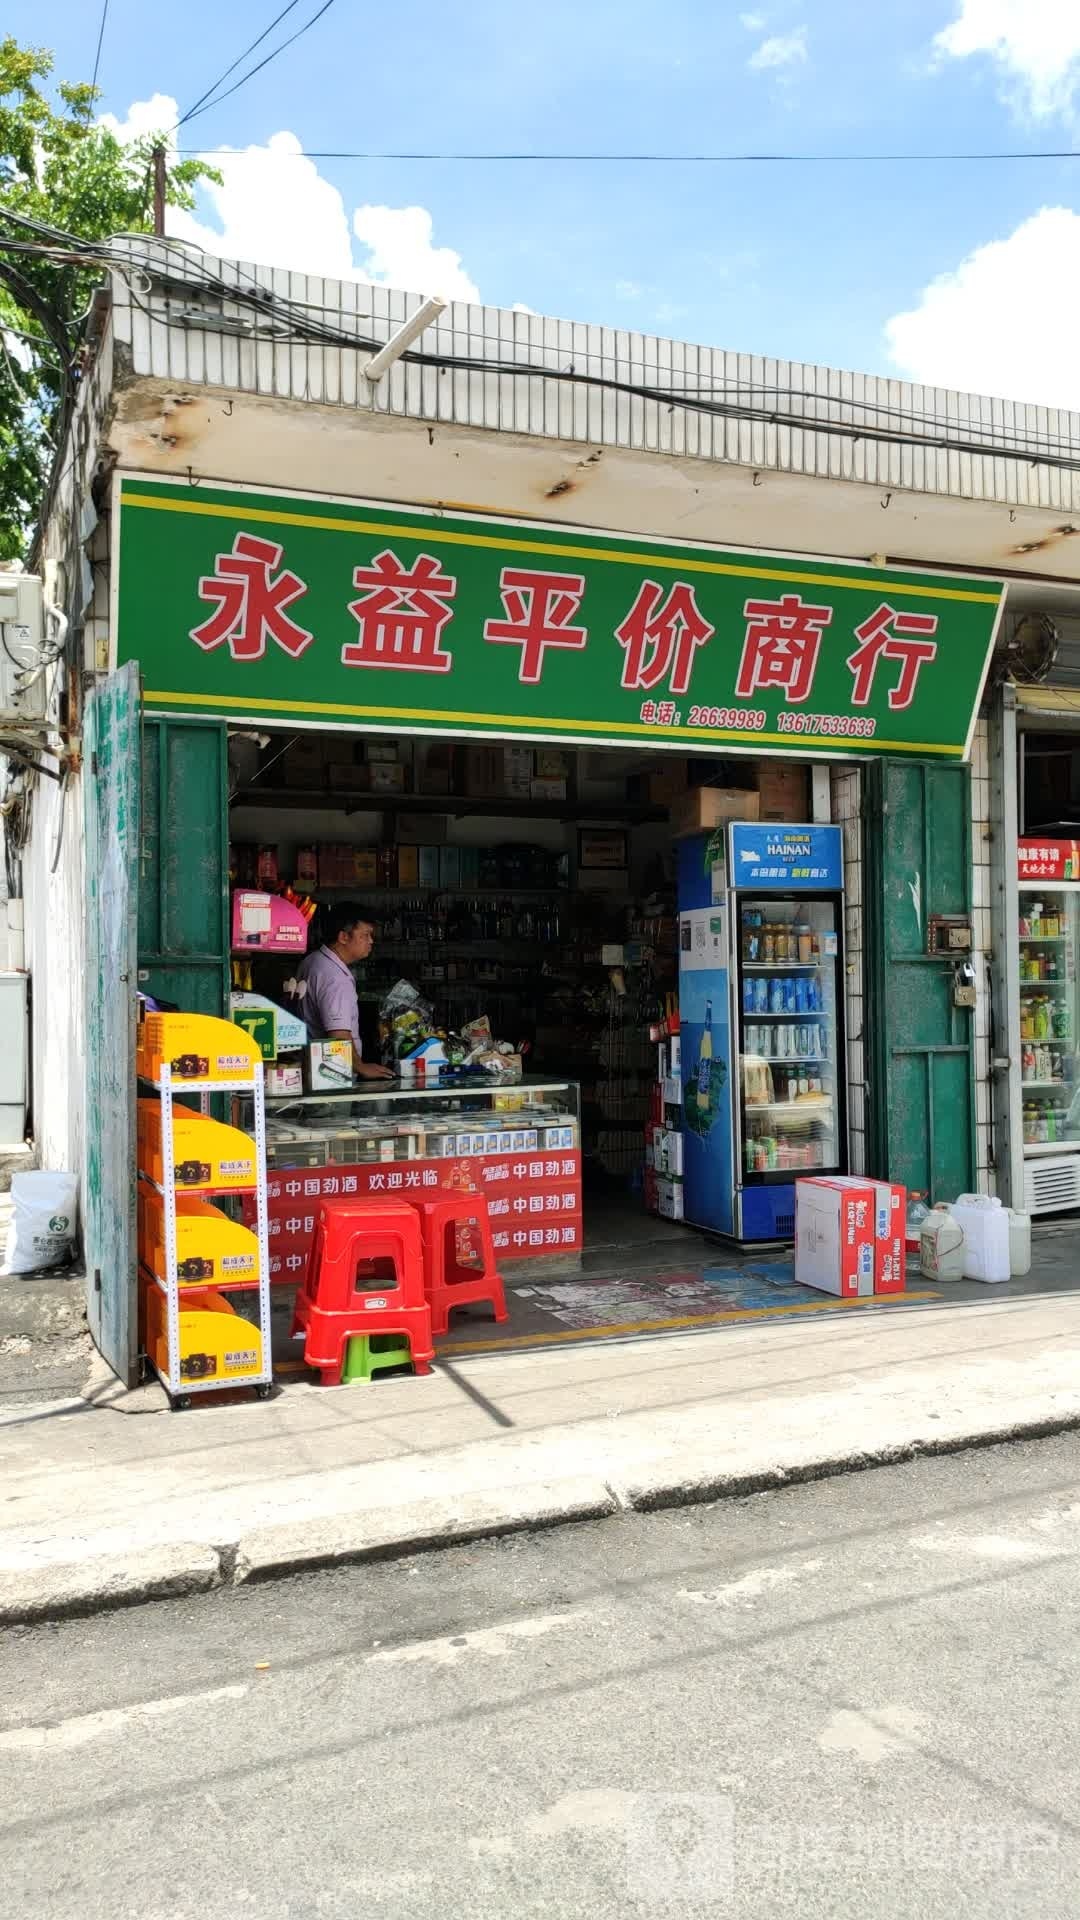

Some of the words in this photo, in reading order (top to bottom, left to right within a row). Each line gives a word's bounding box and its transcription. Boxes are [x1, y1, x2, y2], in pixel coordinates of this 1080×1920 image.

[189, 532, 938, 709] 永益平价商行
[640, 700, 681, 726] 电话：
[687, 705, 766, 730] 26639989
[777, 712, 877, 737] 13617533633
[767, 844, 811, 856] HAINAN
[513, 1160, 576, 1179] 中国劲酒
[285, 1176, 358, 1197] 中国劲酒
[369, 1169, 438, 1191] 欢迎光临
[513, 1194, 576, 1213] 中国劲酒
[513, 1228, 576, 1247] 中国劲酒
